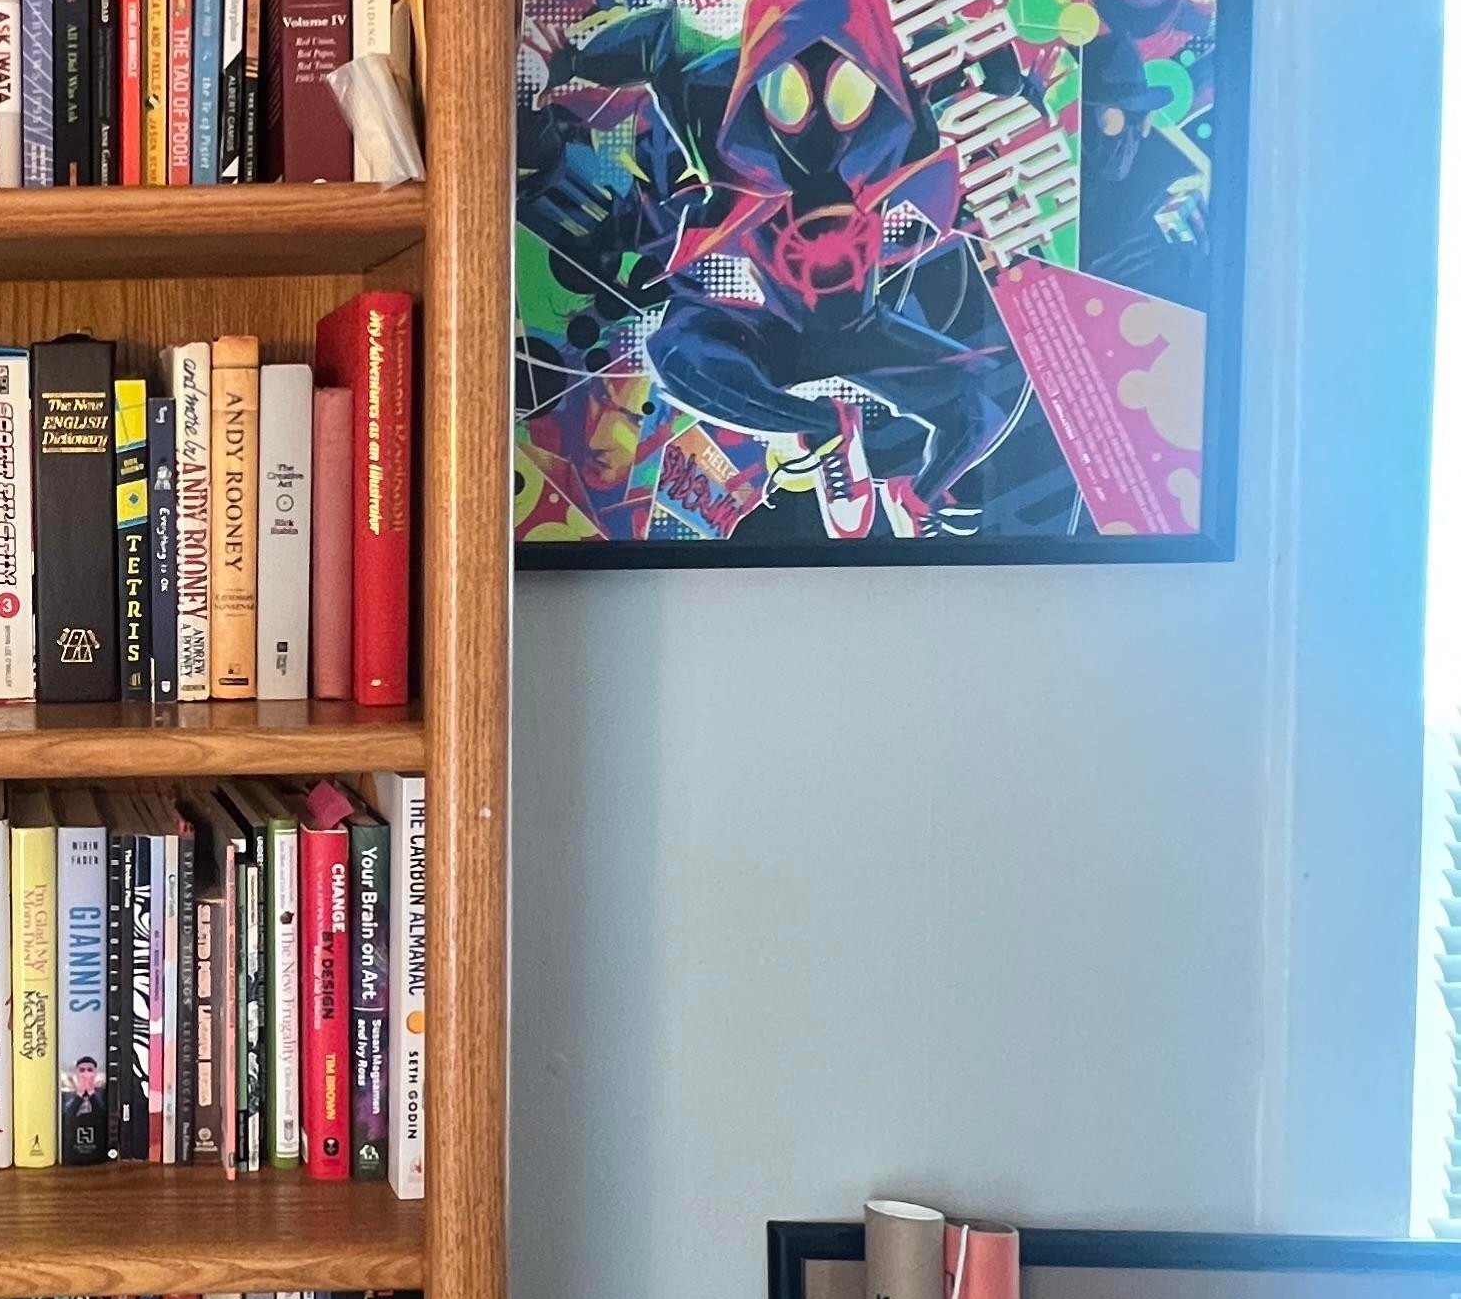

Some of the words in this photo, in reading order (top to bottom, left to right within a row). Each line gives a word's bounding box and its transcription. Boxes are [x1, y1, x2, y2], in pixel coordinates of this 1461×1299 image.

[282, 16, 329, 29] Volume
[331, 14, 348, 27] IV
[172, 27, 190, 58] THE
[172, 61, 190, 93] TAO
[172, 96, 190, 117] OF
[172, 120, 189, 167] POOH
[42, 415, 109, 430] ENGLISH
[49, 398, 71, 413] The
[75, 398, 104, 413] New
[42, 432, 108, 449] Dictionary
[224, 391, 246, 462] ANDY
[223, 469, 244, 573] ROONEY
[2, 597, 12, 613] 3
[124, 534, 143, 662] TETRIS
[360, 846, 379, 887] Your
[330, 862, 346, 933] CHANGE
[360, 890, 380, 940] Brain
[68, 906, 101, 1013] GIANNIS
[320, 930, 336, 955] BY
[362, 943, 377, 963] on
[320, 957, 336, 1019] DESIGN
[362, 967, 380, 1001] Art
[18, 989, 35, 1061] McCurdy
[33, 990, 50, 1058] Jennette
[324, 1052, 336, 1075] TIM
[406, 1050, 420, 1085] SETH
[324, 1075, 336, 1121] BROWN
[406, 1089, 420, 1140] GODIN
